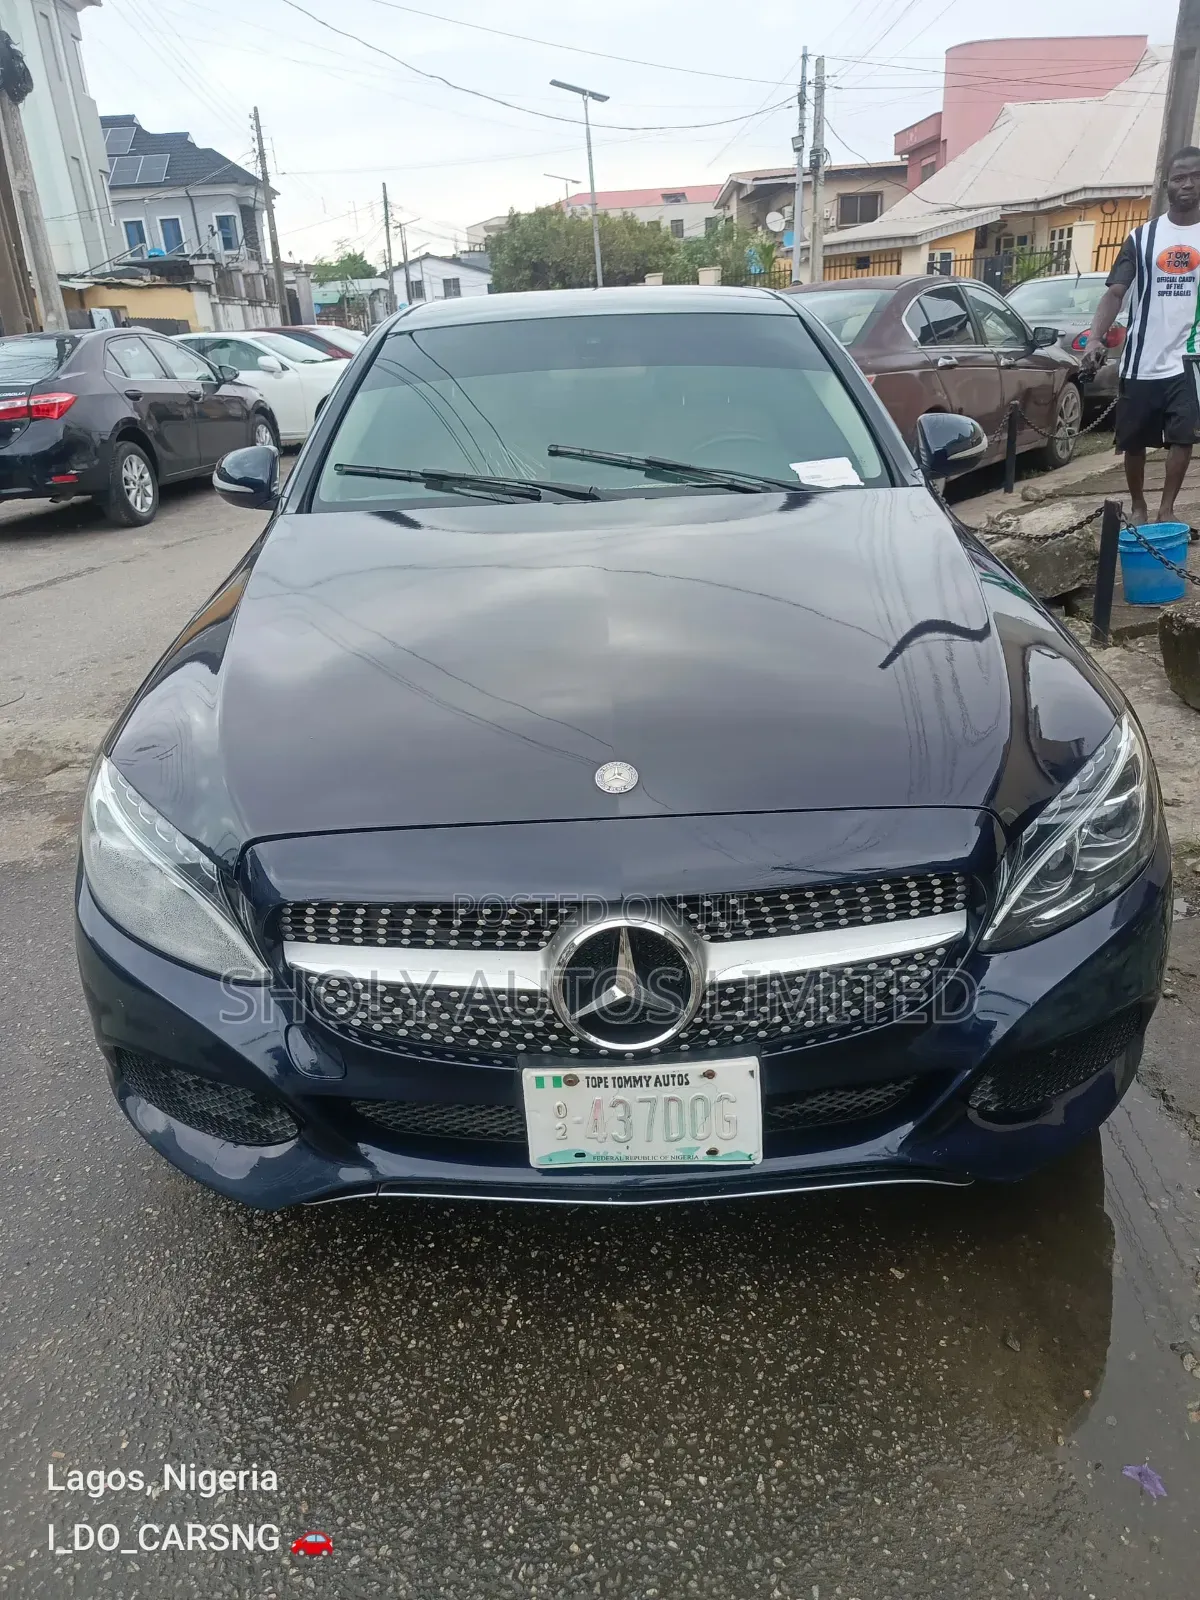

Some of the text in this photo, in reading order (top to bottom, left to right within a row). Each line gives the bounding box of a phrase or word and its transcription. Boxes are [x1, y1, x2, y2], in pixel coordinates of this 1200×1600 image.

[584, 1073, 690, 1089] TOPE TOMMY AUTOS
